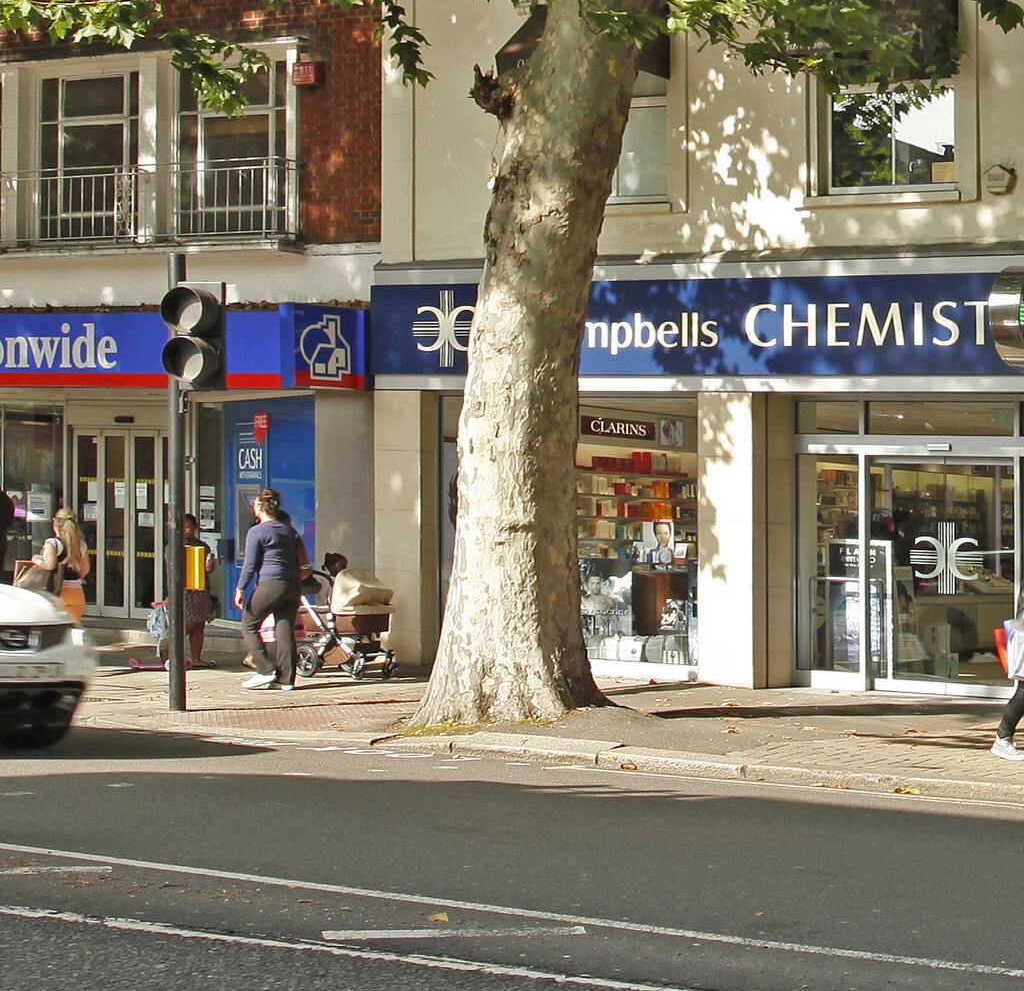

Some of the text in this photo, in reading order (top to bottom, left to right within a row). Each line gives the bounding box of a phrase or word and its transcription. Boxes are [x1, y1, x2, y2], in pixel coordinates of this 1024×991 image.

[0, 322, 118, 369] nwide
[585, 301, 988, 356] mpbells CHEMIST
[590, 420, 647, 437] CLARINS
[238, 448, 263, 470] CASH
